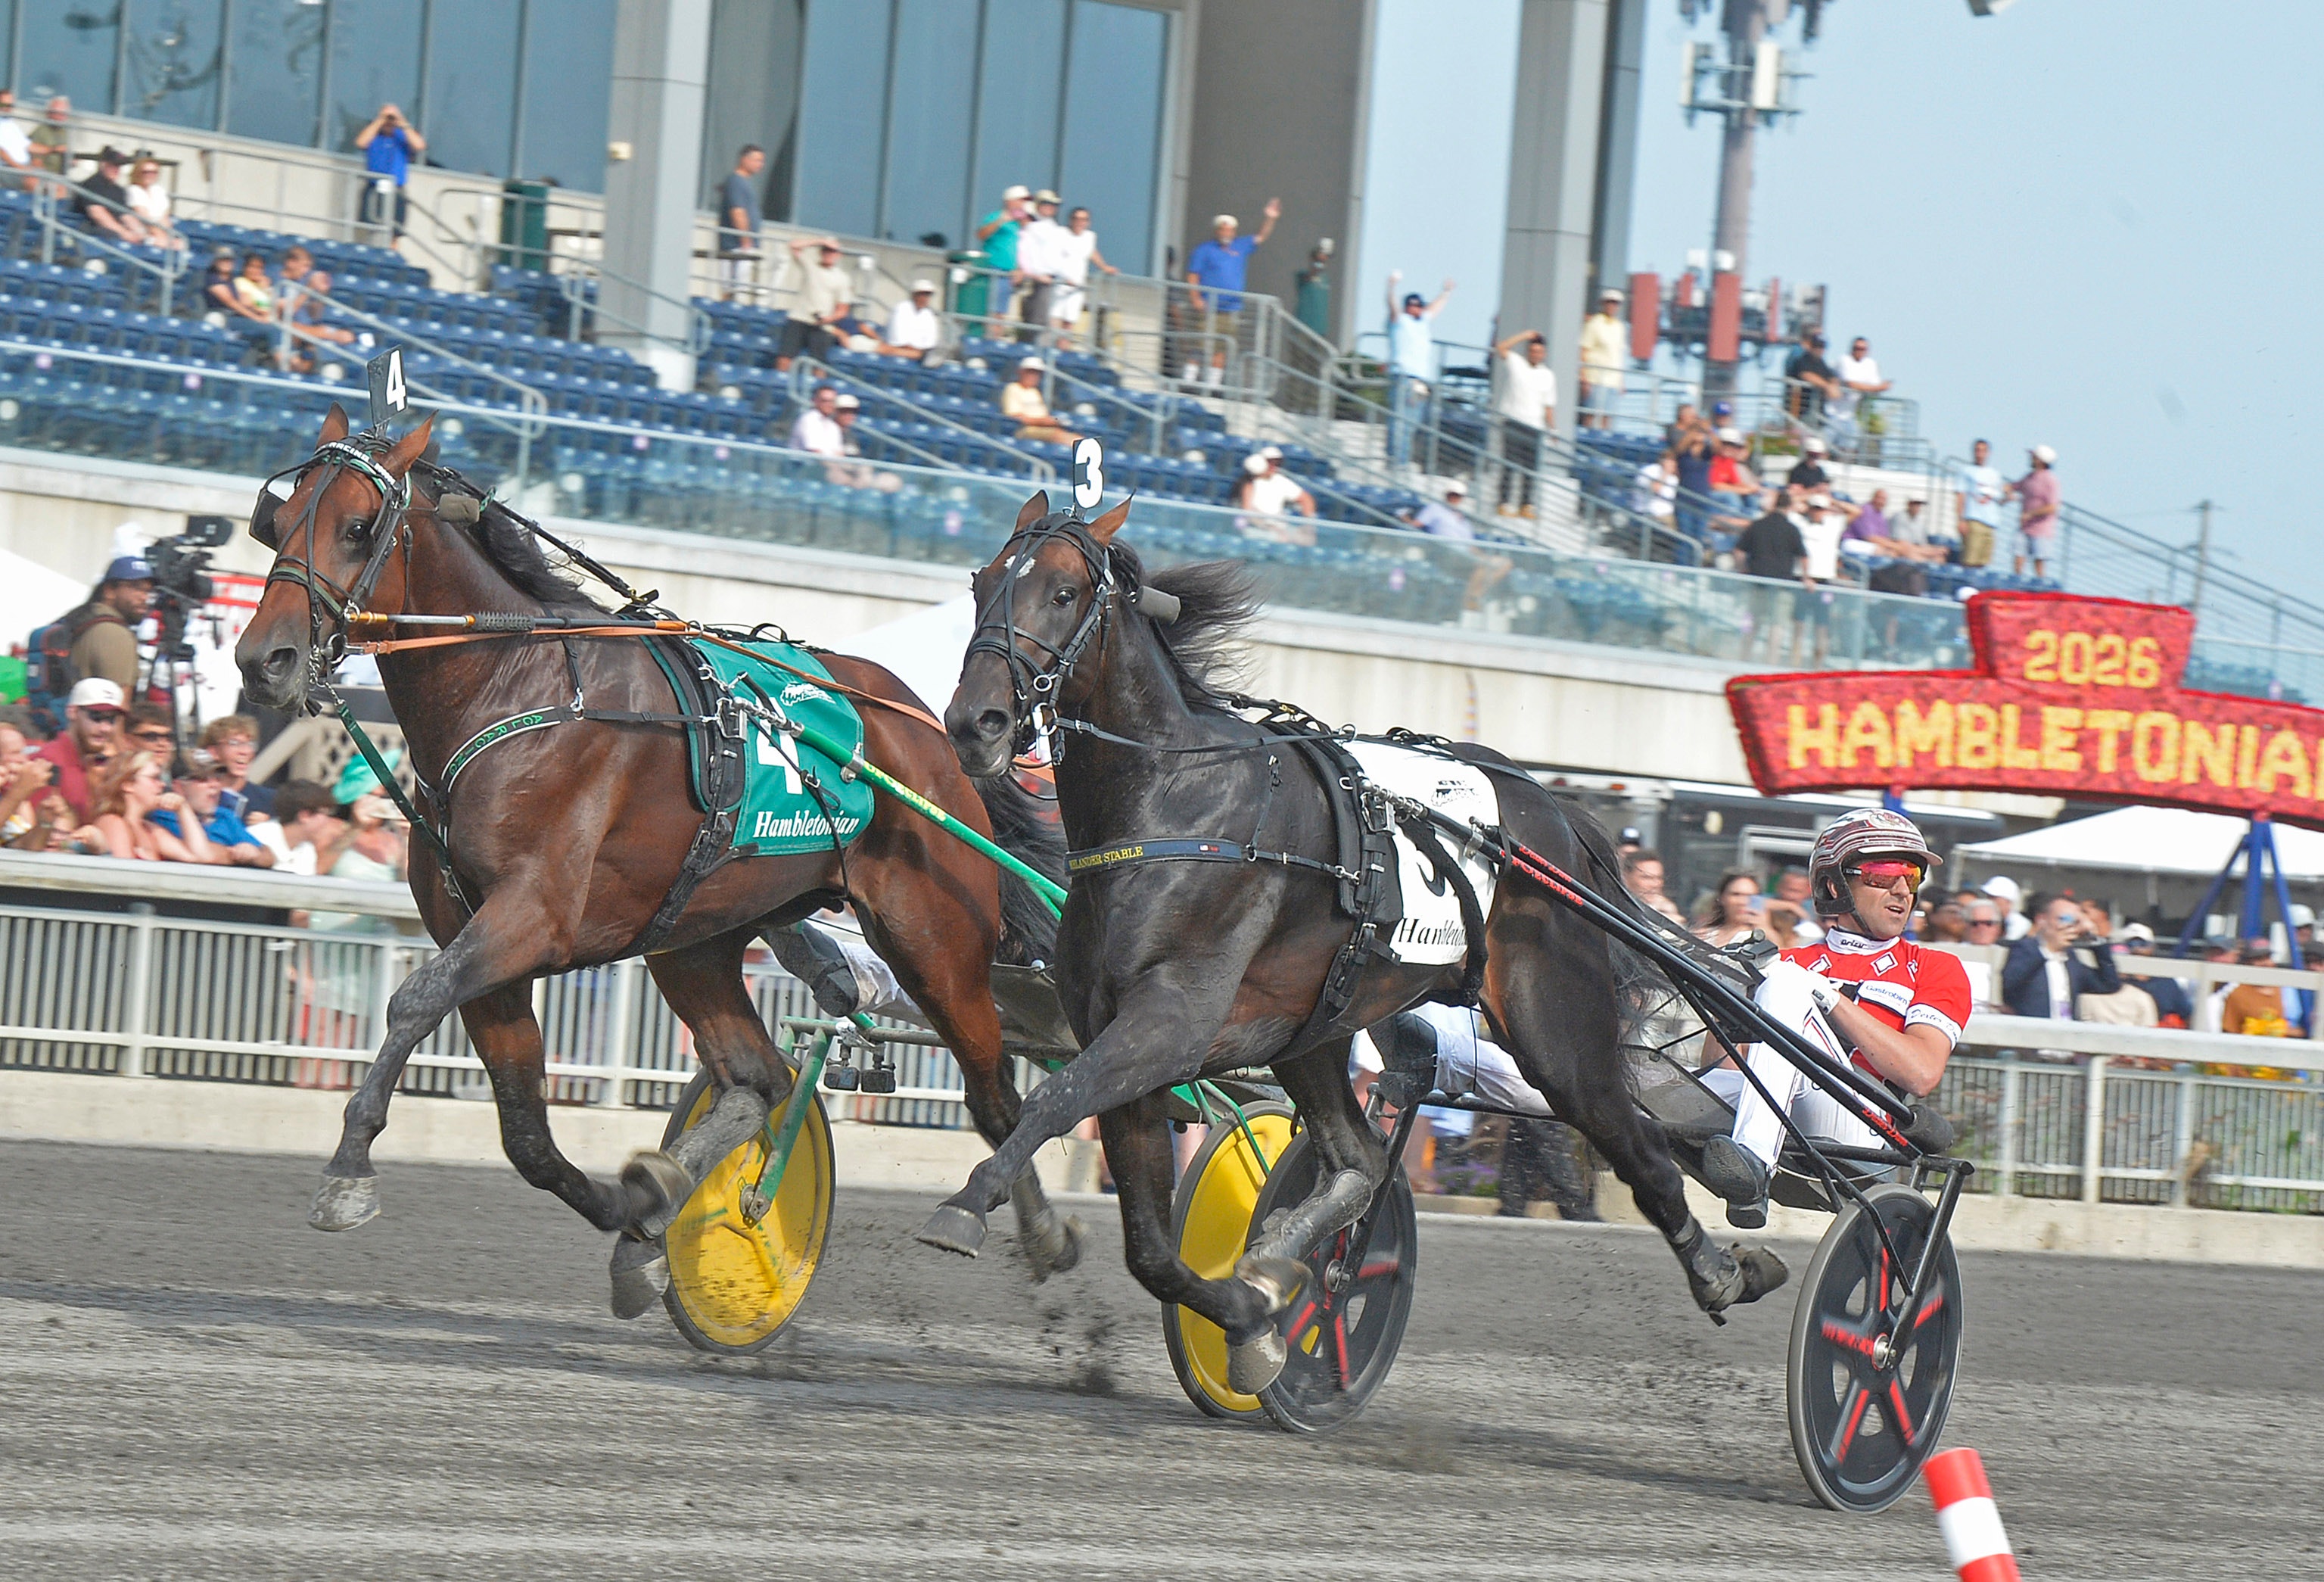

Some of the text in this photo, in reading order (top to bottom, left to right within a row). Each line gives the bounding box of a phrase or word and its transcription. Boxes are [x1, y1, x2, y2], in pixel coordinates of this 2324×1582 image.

[386, 350, 406, 412] 4
[1075, 438, 1103, 508] 3
[2024, 629, 2160, 688] 2026
[757, 697, 803, 795] 4
[1787, 699, 2324, 801] HAMBLETONIA
[752, 809, 860, 838] Hambletonian
[1103, 845, 1143, 863] STABLE
